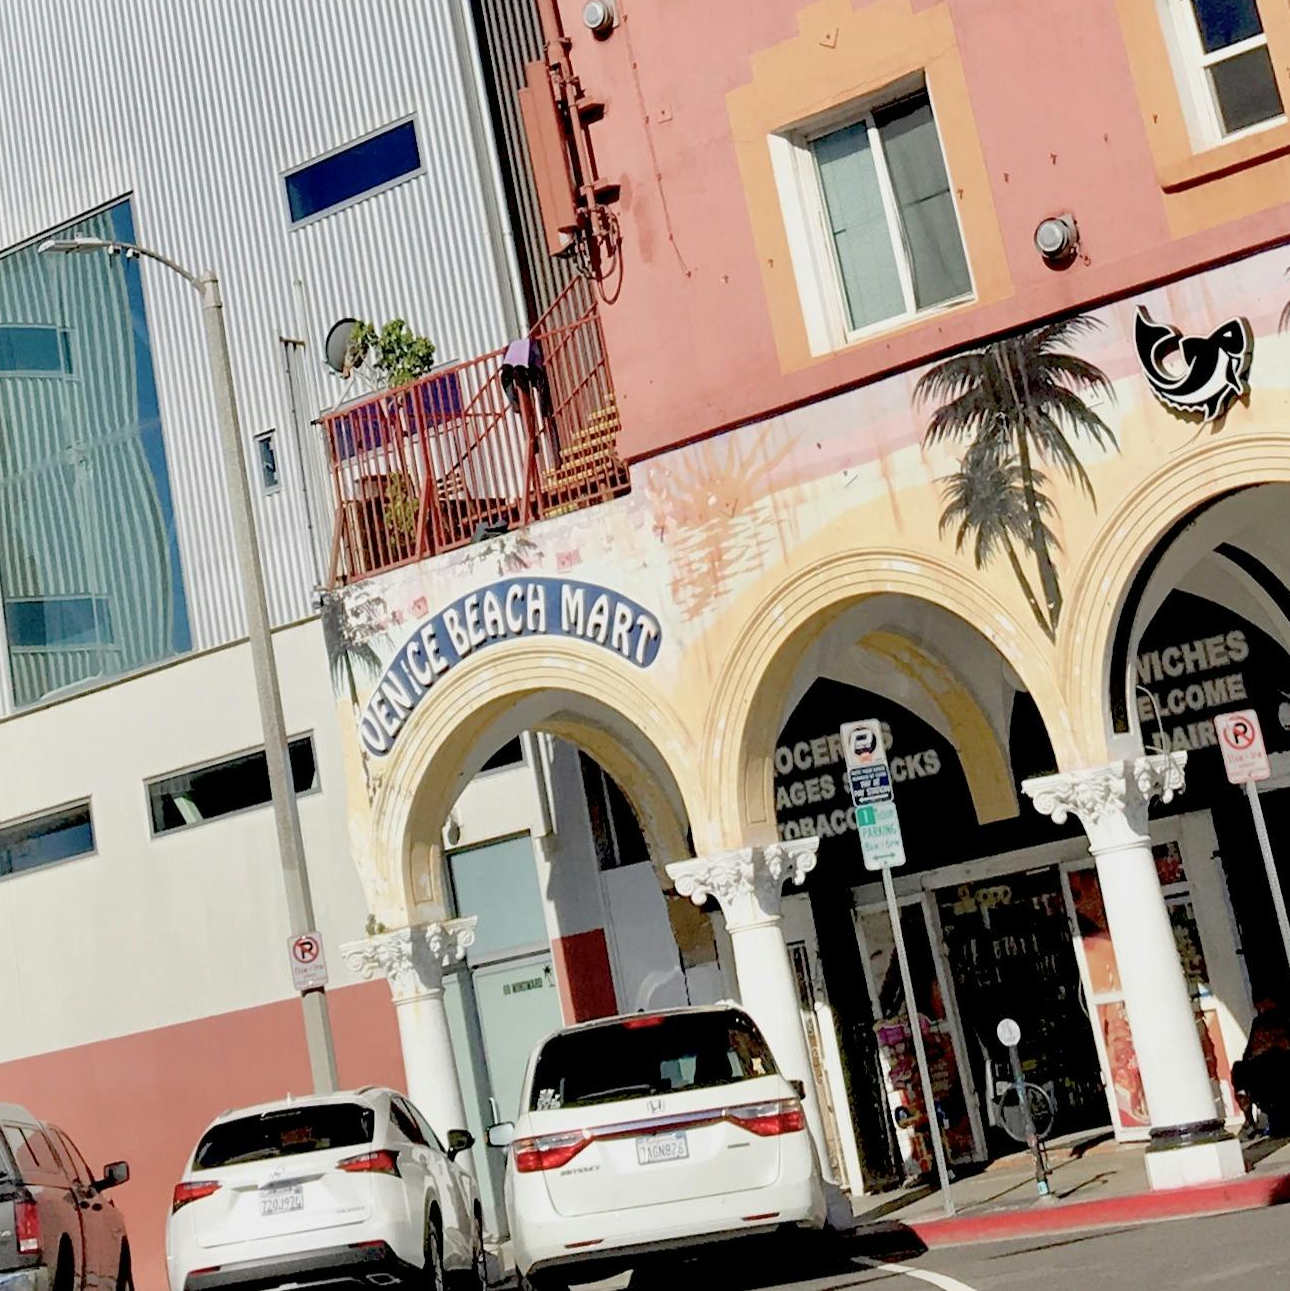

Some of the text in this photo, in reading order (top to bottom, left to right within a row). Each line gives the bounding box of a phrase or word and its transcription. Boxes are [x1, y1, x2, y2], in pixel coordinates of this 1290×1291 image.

[360, 583, 659, 753] VENICE BEACH MART
[1136, 673, 1248, 721] ELCOME
[1152, 718, 1218, 752] DAIR
[776, 774, 836, 810] AGES
